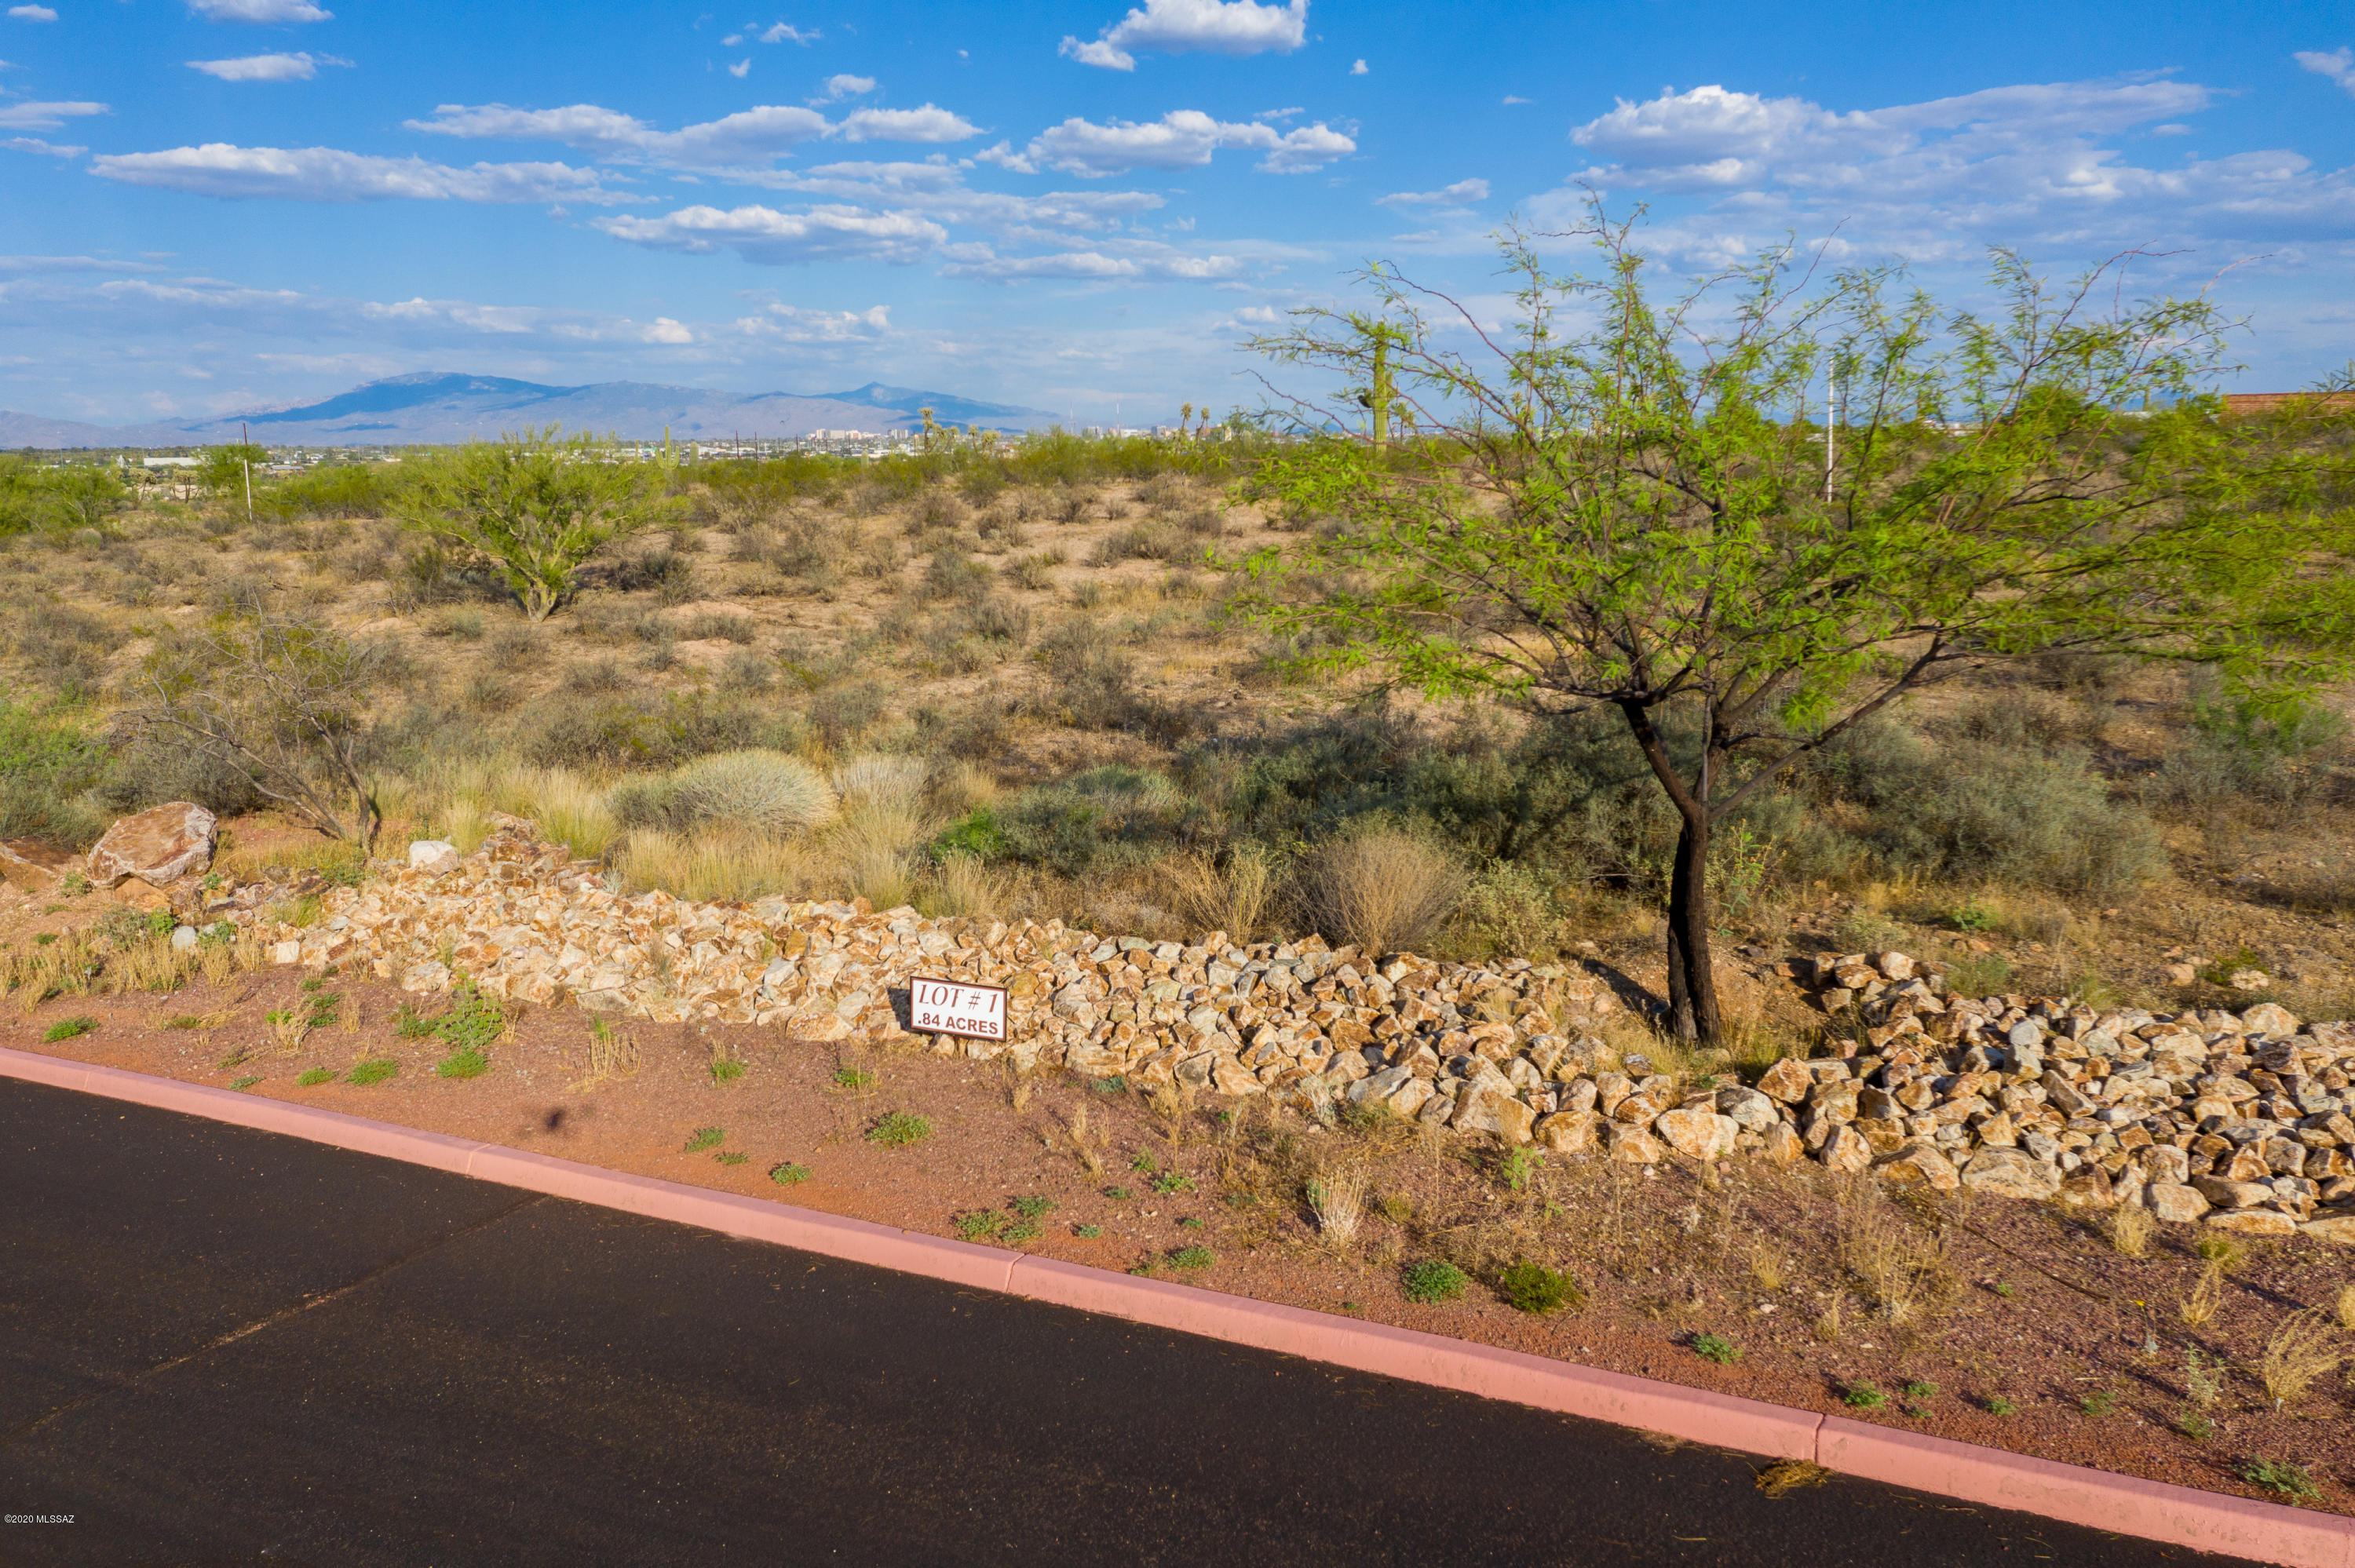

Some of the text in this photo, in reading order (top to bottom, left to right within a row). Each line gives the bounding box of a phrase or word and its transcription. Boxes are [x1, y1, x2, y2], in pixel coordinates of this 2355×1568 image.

[918, 984, 964, 1008] LOT
[918, 1012, 999, 1034] .84 ACRES
